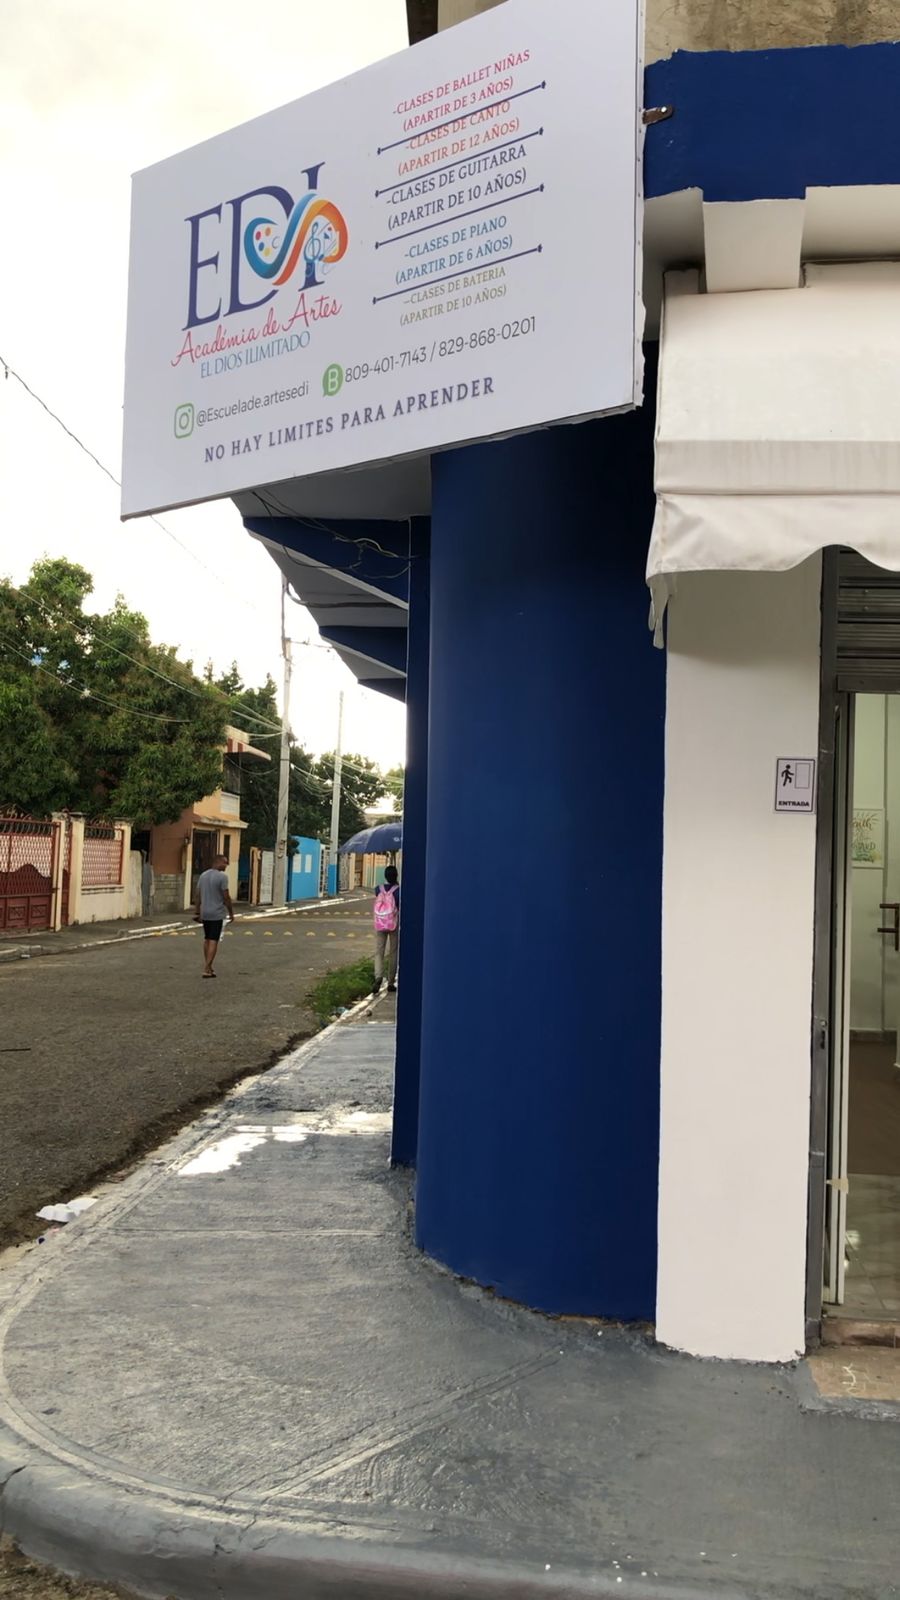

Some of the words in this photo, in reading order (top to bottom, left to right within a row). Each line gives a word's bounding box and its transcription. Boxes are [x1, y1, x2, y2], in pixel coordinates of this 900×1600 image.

[393, 90, 434, 115] -CLASES
[436, 83, 451, 98] DE
[453, 66, 491, 91] BALLET
[493, 49, 530, 74] NIÑAS
[403, 103, 451, 132] (APARTIR
[453, 96, 468, 111] DE
[470, 92, 477, 105] 3
[478, 76, 514, 101] AÑOS)
[398, 147, 449, 176] (APARTIR
[451, 140, 466, 155] DE
[469, 134, 480, 148] 12
[482, 117, 520, 143] AÑOS)
[405, 122, 449, 150] -CLASES
[452, 116, 467, 133] DE
[469, 101, 511, 126] CANTO
[386, 178, 435, 205] -CLASES
[438, 170, 456, 188] DE
[458, 144, 527, 180] GUITARRA
[388, 198, 445, 231] (APARTIR
[447, 193, 465, 209] DE
[468, 185, 481, 201] 10
[484, 167, 527, 196] AÑOS)
[181, 161, 326, 331] EDI
[395, 257, 447, 285] (APARTIR
[449, 251, 464, 267] DE
[466, 248, 473, 261] 6
[475, 235, 513, 259] AÑOS)
[404, 234, 449, 258] -CLASES
[451, 228, 467, 245] DE
[470, 215, 507, 238] PIANO
[400, 303, 444, 327] (APARTIR
[446, 299, 460, 313] DE
[462, 295, 472, 308] 10
[474, 284, 507, 305] AÑOS)
[448, 278, 461, 293] DE
[171, 324, 260, 367] Académia
[262, 307, 281, 338] de
[281, 292, 343, 331] Artes
[200, 362, 212, 379] EL
[215, 350, 243, 375] DIOS
[245, 330, 311, 366] ILIMITADO
[197, 380, 309, 427] @Escuelade.artesedi
[345, 346, 427, 383] 809-401-7143
[430, 341, 437, 362] /
[438, 316, 536, 357] 829-868-0201
[204, 445, 225, 463] NO
[231, 435, 262, 456] HAY
[268, 416, 334, 448] LIMITES
[341, 404, 386, 430] PARA
[393, 376, 495, 417] APRENDER
